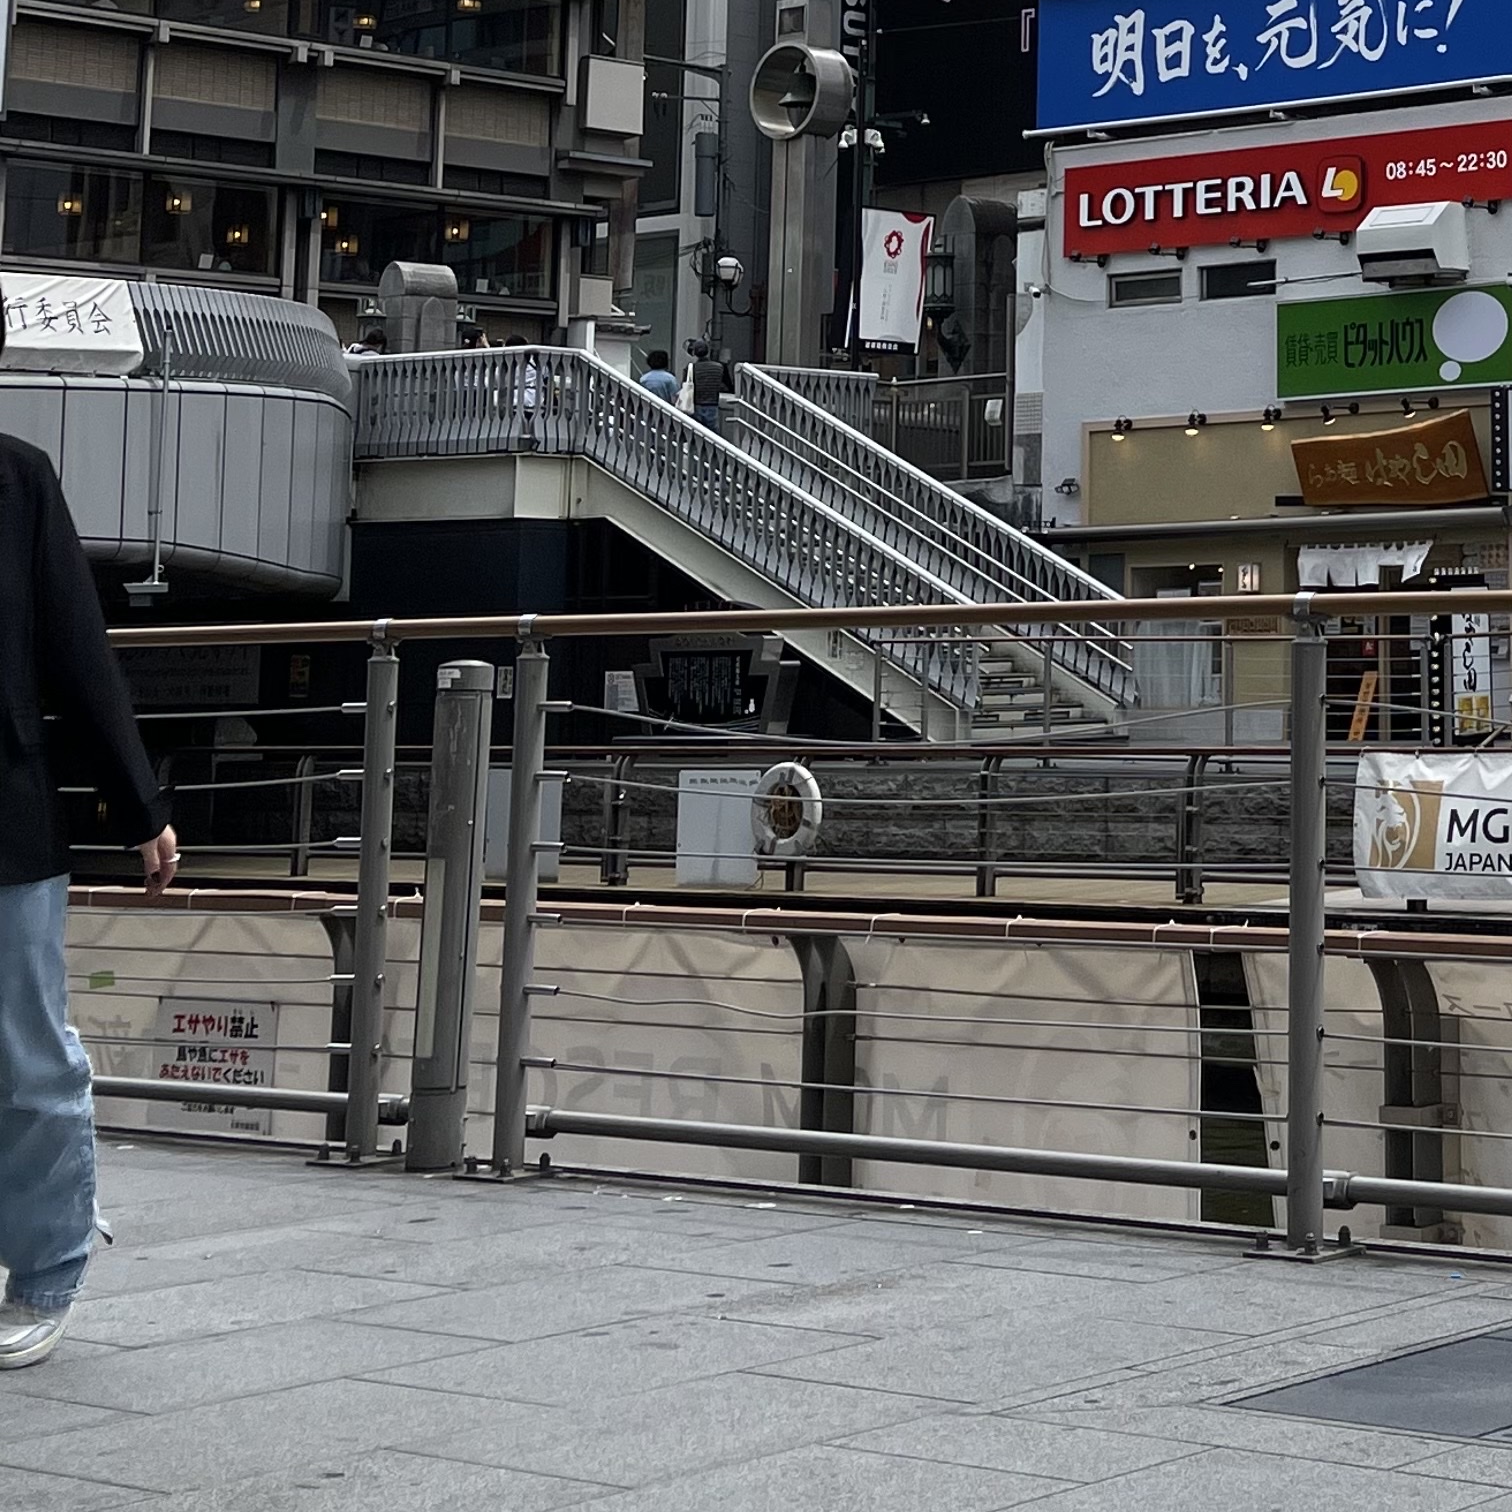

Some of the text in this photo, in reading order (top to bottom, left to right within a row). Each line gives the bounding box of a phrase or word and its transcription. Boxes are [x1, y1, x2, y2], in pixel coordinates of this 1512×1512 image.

[1078, 170, 1308, 228] LOTTERIA
[1343, 317, 1428, 369] ピタットハウス
[172, 1014, 259, 1039] エサやり禁止
[159, 1064, 265, 1085] あたえないでください
